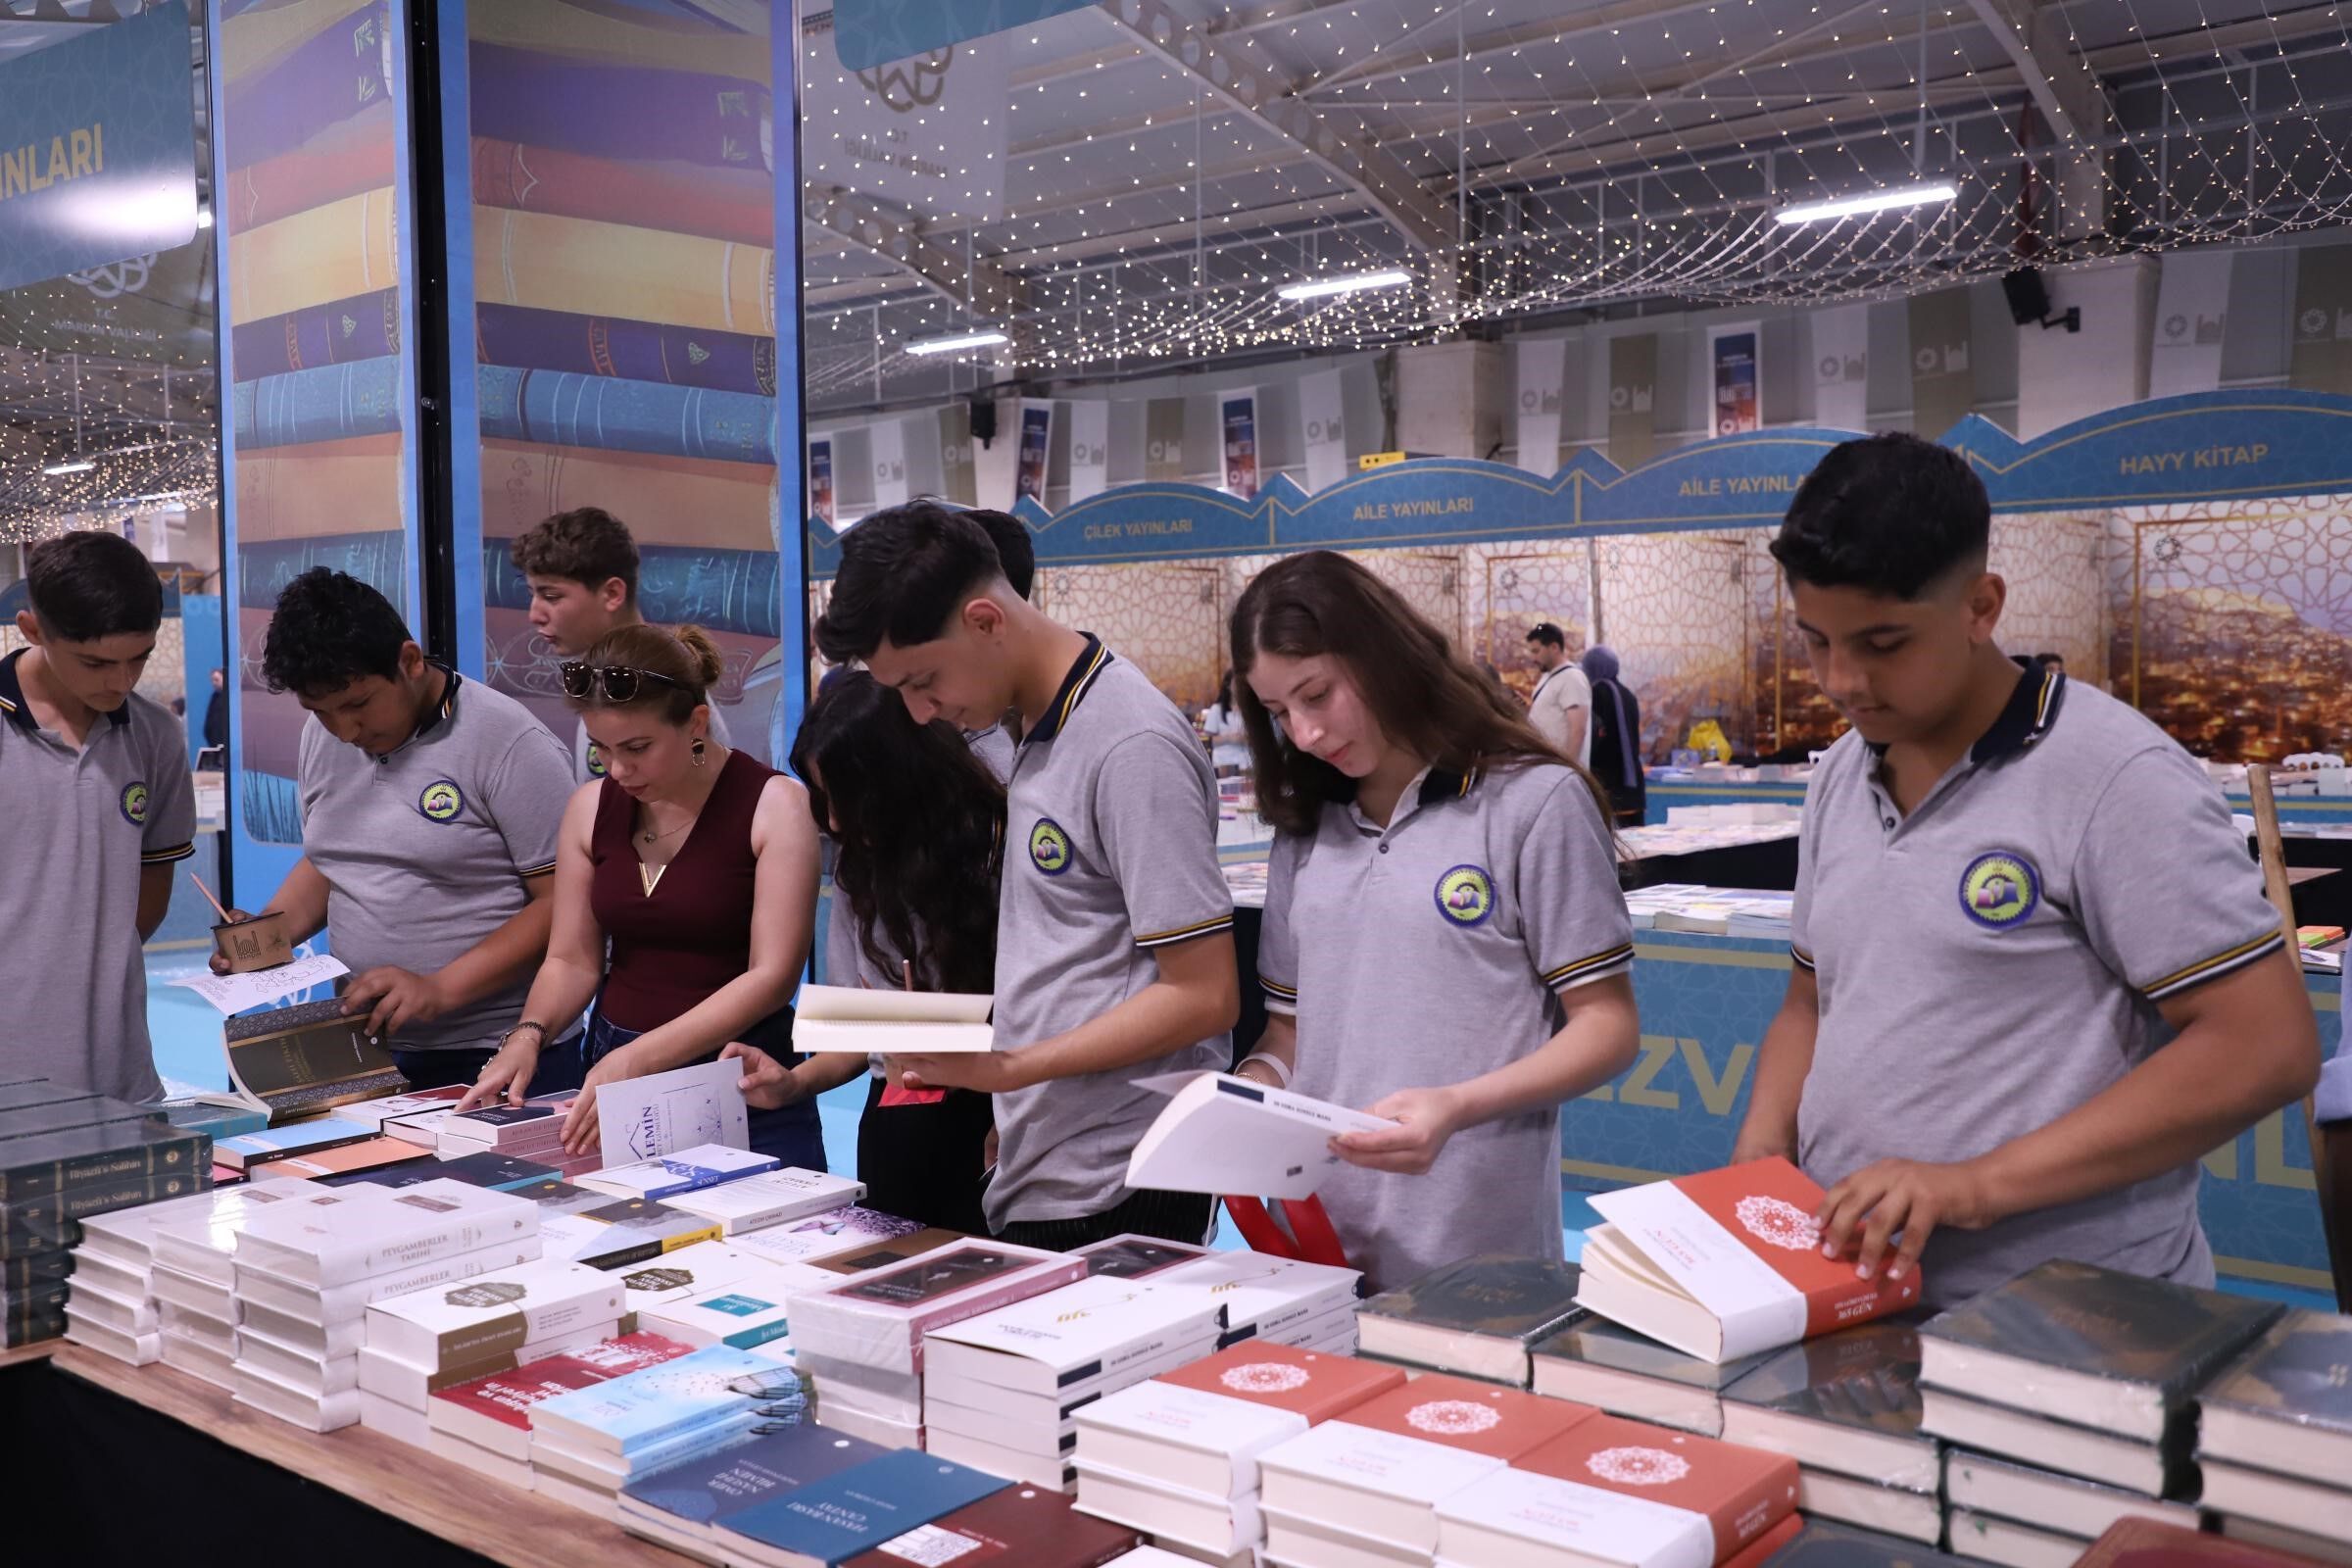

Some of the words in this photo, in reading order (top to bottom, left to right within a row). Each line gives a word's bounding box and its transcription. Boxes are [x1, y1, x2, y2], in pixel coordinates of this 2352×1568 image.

[2121, 454, 2187, 475] HAYY
[2193, 444, 2269, 468] KİTAP
[1678, 477, 1721, 496] AİLE
[1353, 503, 1388, 519] AİLE
[1392, 498, 1473, 517] YAYINLARI
[1085, 523, 1122, 542] ÇİLEK
[1125, 518, 1193, 536] YAYINLARI
